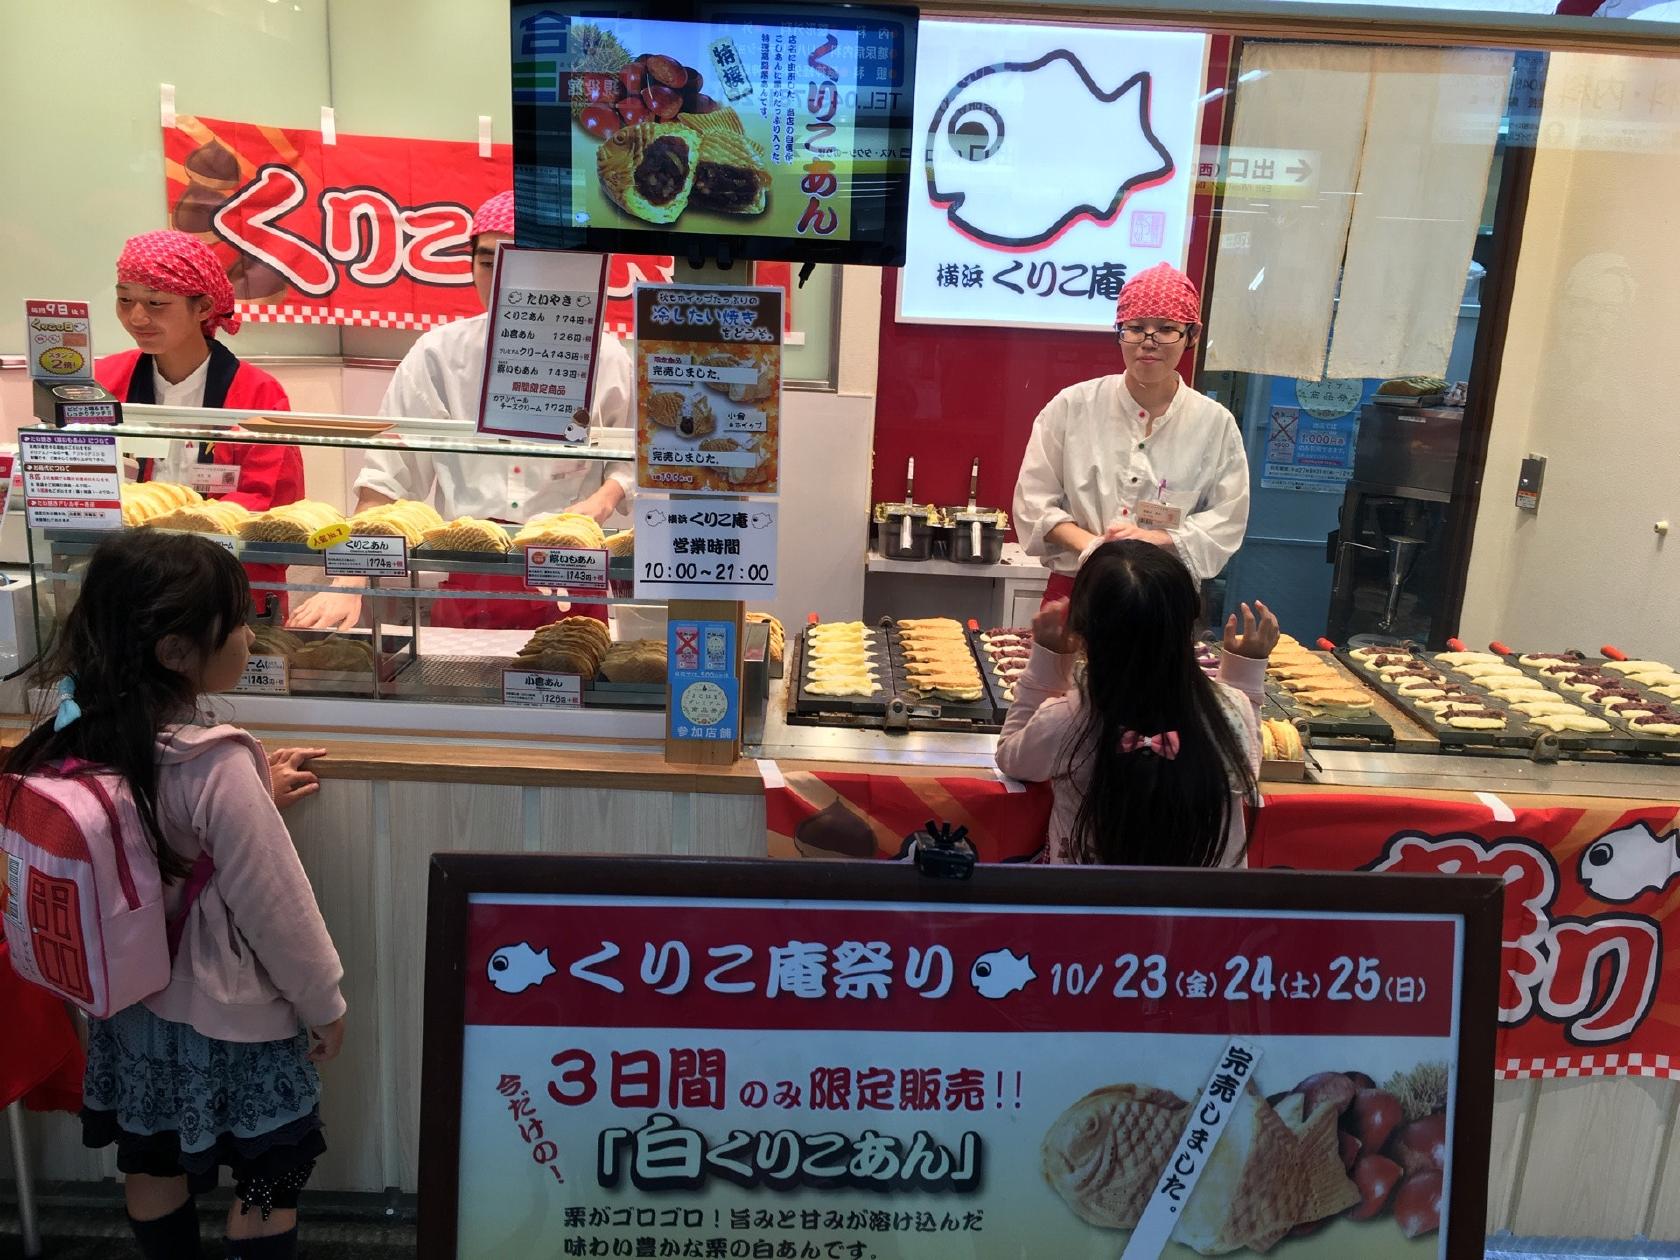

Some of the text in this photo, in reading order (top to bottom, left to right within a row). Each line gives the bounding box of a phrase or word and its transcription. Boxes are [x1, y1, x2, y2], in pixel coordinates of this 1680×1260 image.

[796, 33, 838, 234] くりこあん
[936, 259, 1128, 300] 横浜 くりこ庵
[527, 293, 572, 306] たいやき
[504, 311, 545, 322] くりこあん
[653, 306, 757, 326] 冷したい焼き
[501, 328, 535, 340] 小倉あん
[721, 327, 773, 341] をどうぞ。
[652, 366, 720, 380] 完売しました。
[512, 381, 566, 396] 期間限定商品
[652, 451, 719, 465] 完売しました。
[668, 511, 749, 529] 横浜 くりこ庵
[345, 540, 389, 550] くりこあん
[672, 537, 741, 555] 営業時間
[525, 675, 563, 687] 小倉あん
[677, 726, 732, 738] 参加店舗
[568, 940, 954, 1000] くりこ庵祭り
[1160, 1045, 1254, 1213] 完売しました。
[598, 1114, 983, 1192] 「白くりこあん」
[564, 1237, 878, 1260] 味わい豊かな栗の白あんです。
